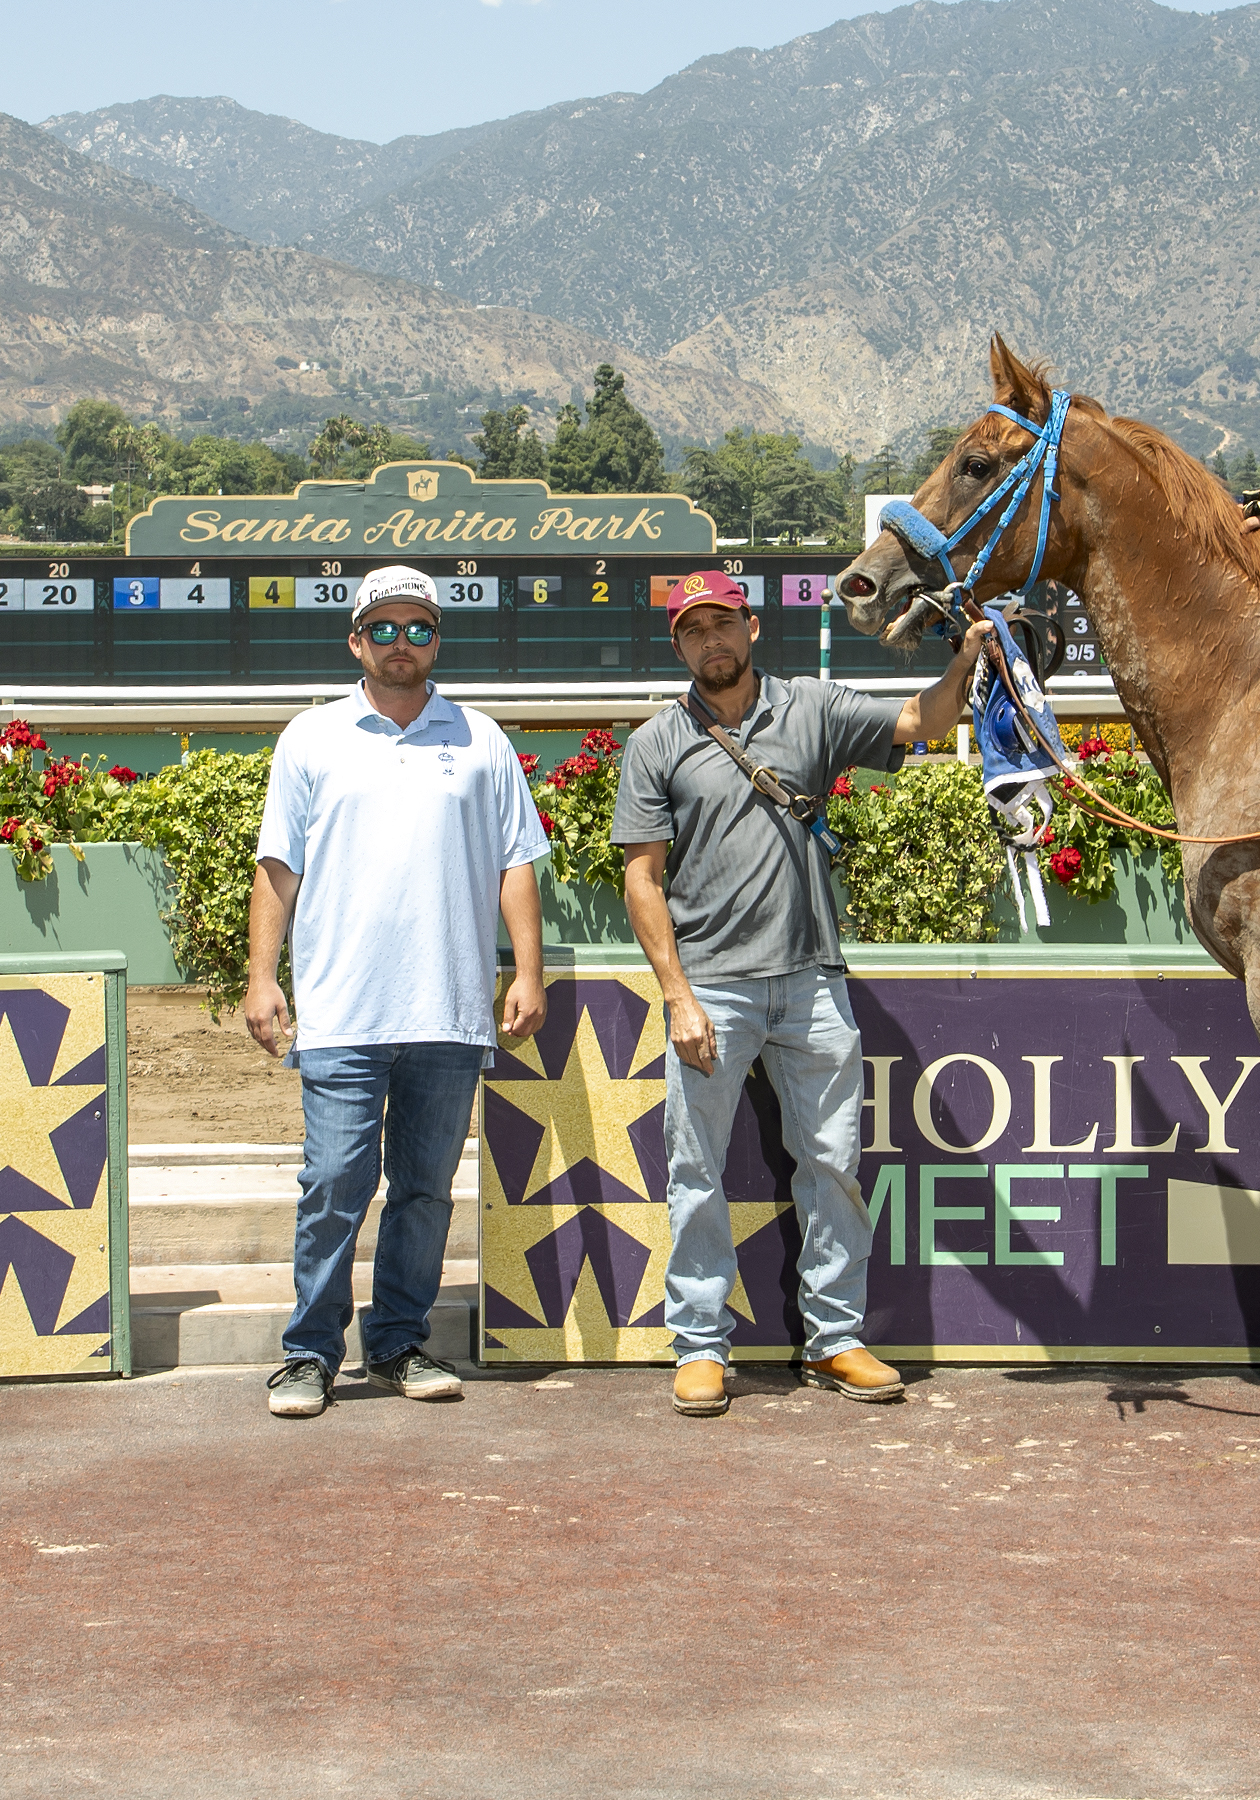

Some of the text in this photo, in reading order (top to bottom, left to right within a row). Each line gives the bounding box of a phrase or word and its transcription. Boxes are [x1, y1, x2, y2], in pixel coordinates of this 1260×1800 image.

[180, 507, 664, 547] Santa Anita Park
[49, 563, 70, 578] 20
[190, 562, 201, 577] 4
[321, 561, 342, 576] 30
[457, 560, 478, 576] 30
[595, 560, 606, 575] 2
[723, 559, 743, 575] 30
[42, 585, 77, 605] 20
[129, 580, 205, 606] 3 4
[265, 581, 348, 604] 4 30
[369, 582, 427, 602] CHAMPIONS
[450, 583, 483, 602] 30
[533, 579, 609, 603] 6 2
[799, 579, 811, 601] 8
[1073, 617, 1088, 634] 3
[1066, 644, 1095, 661] 9/5
